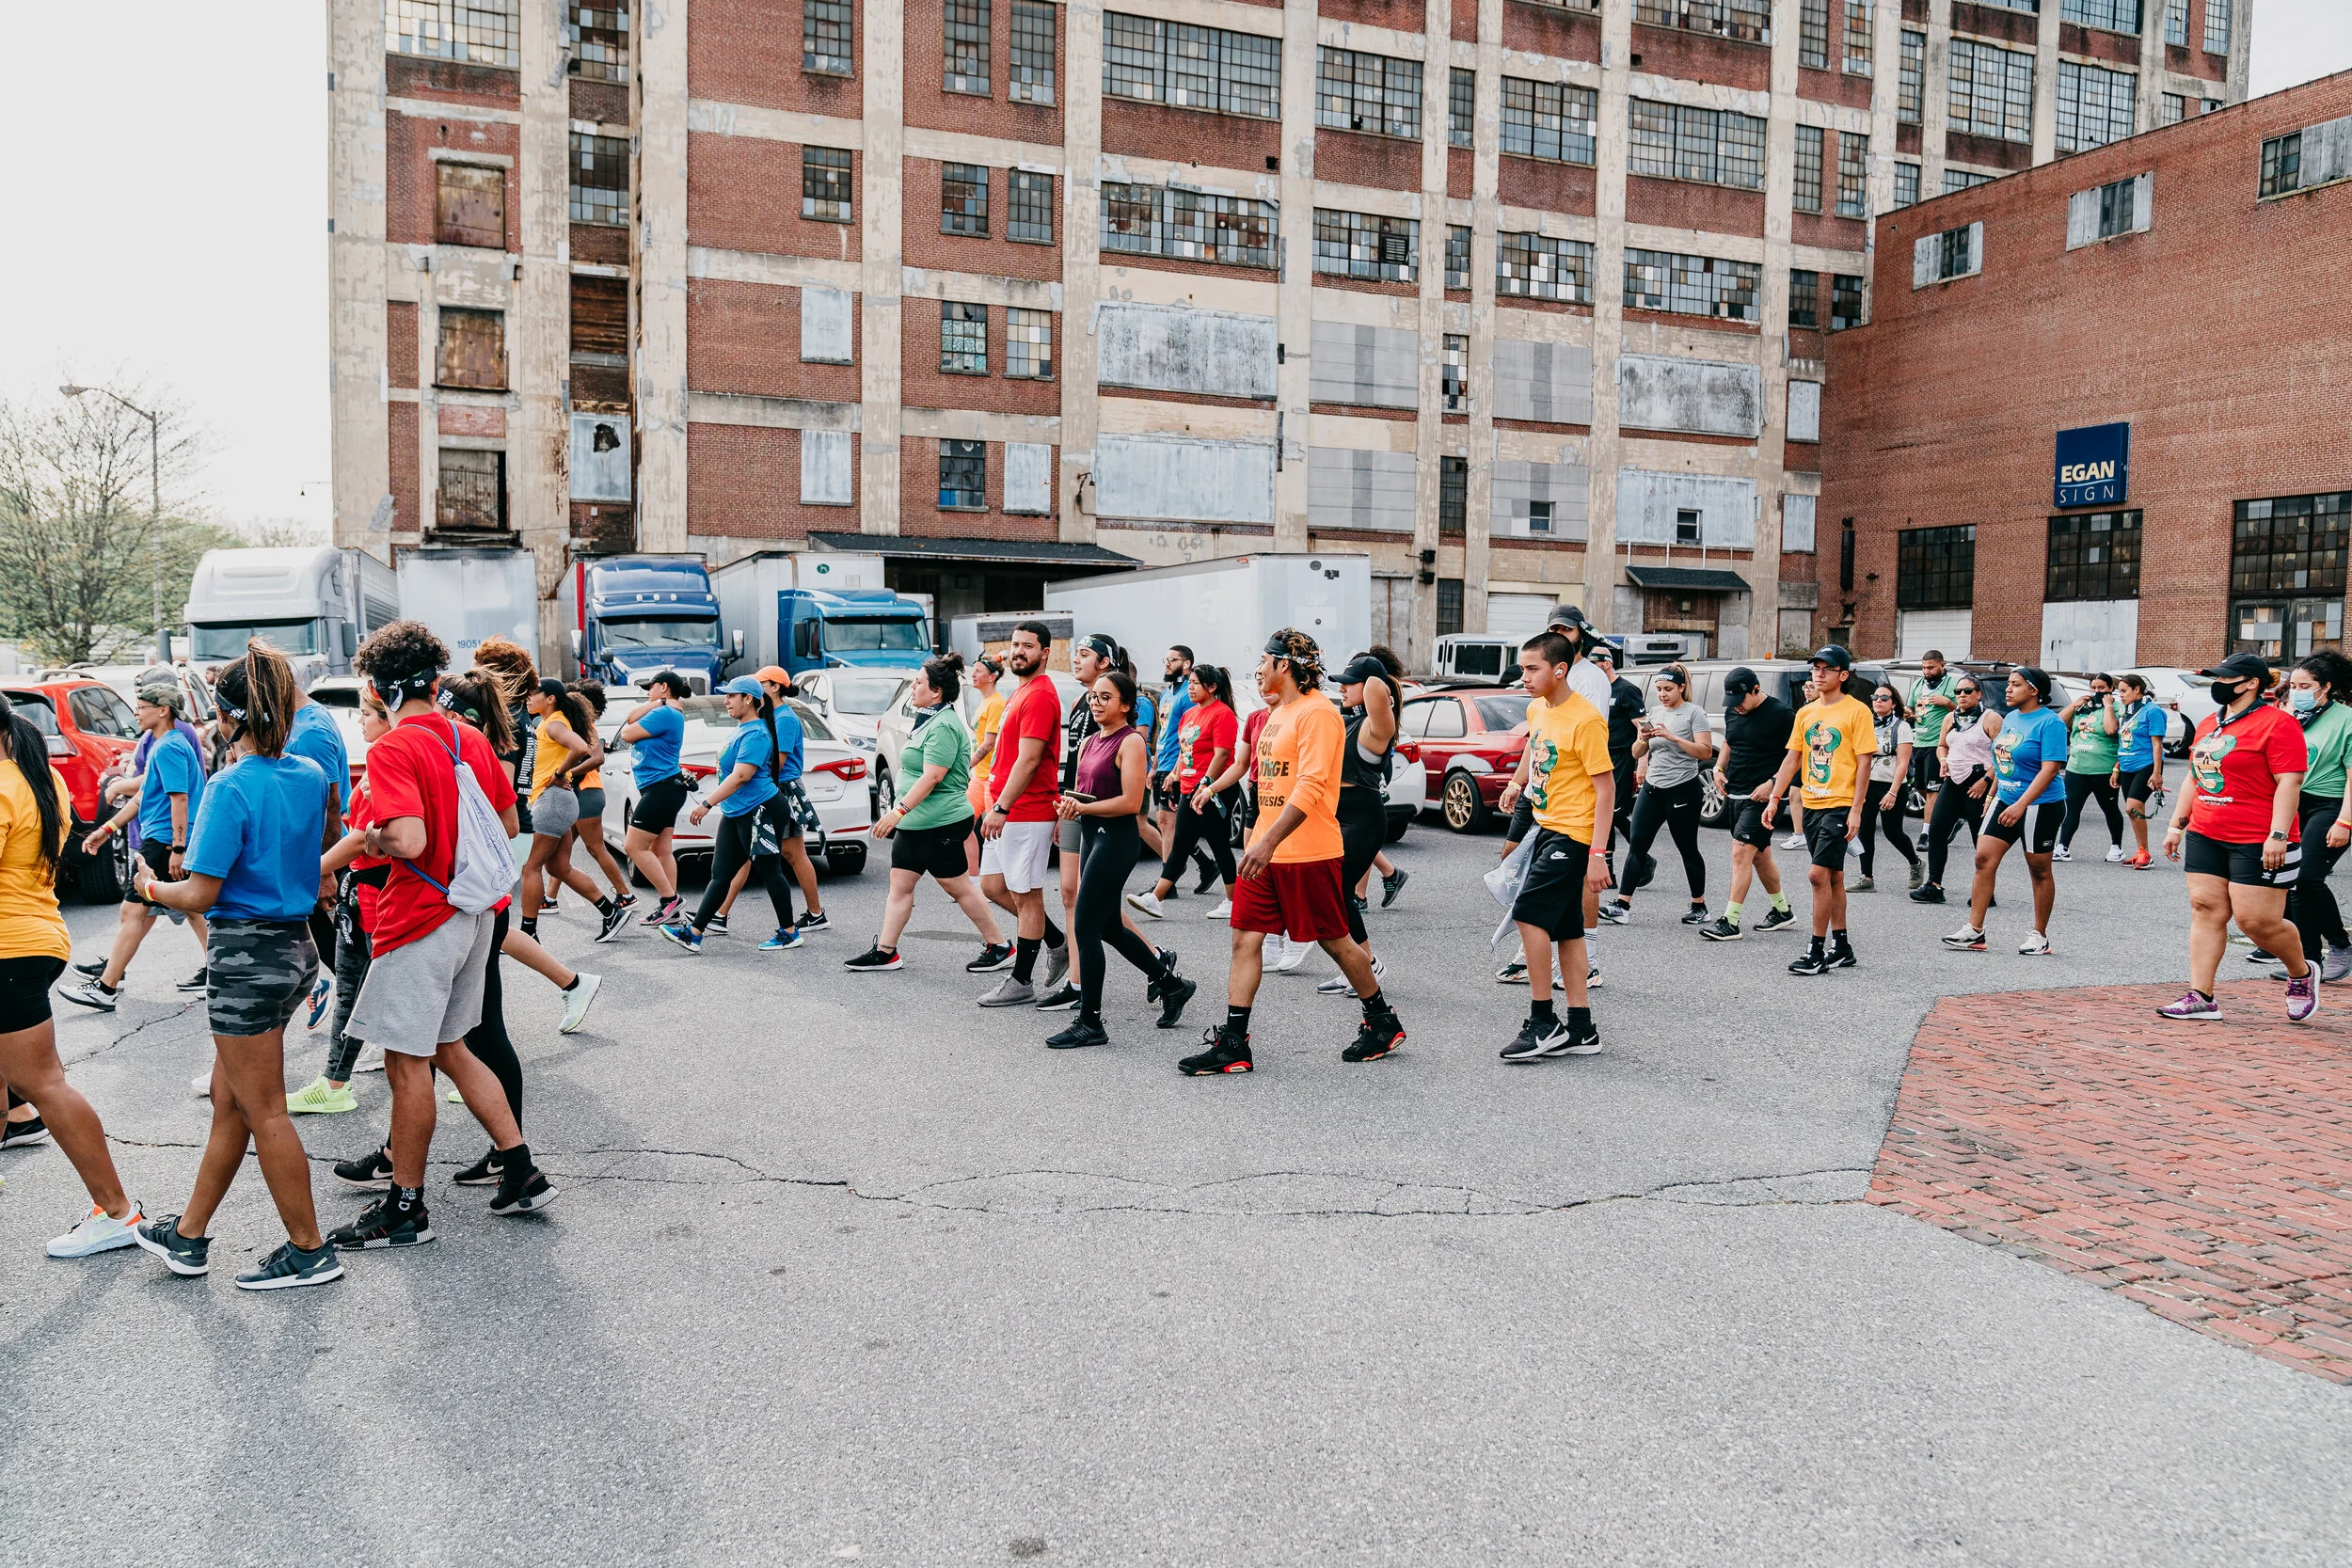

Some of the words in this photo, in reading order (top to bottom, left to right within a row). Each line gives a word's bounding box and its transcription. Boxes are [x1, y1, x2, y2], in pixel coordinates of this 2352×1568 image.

[2061, 460, 2115, 483] EGAN
[2059, 485, 2114, 503] SIGN
[1262, 723, 1282, 737] RUN
[1258, 741, 1273, 756] FOR
